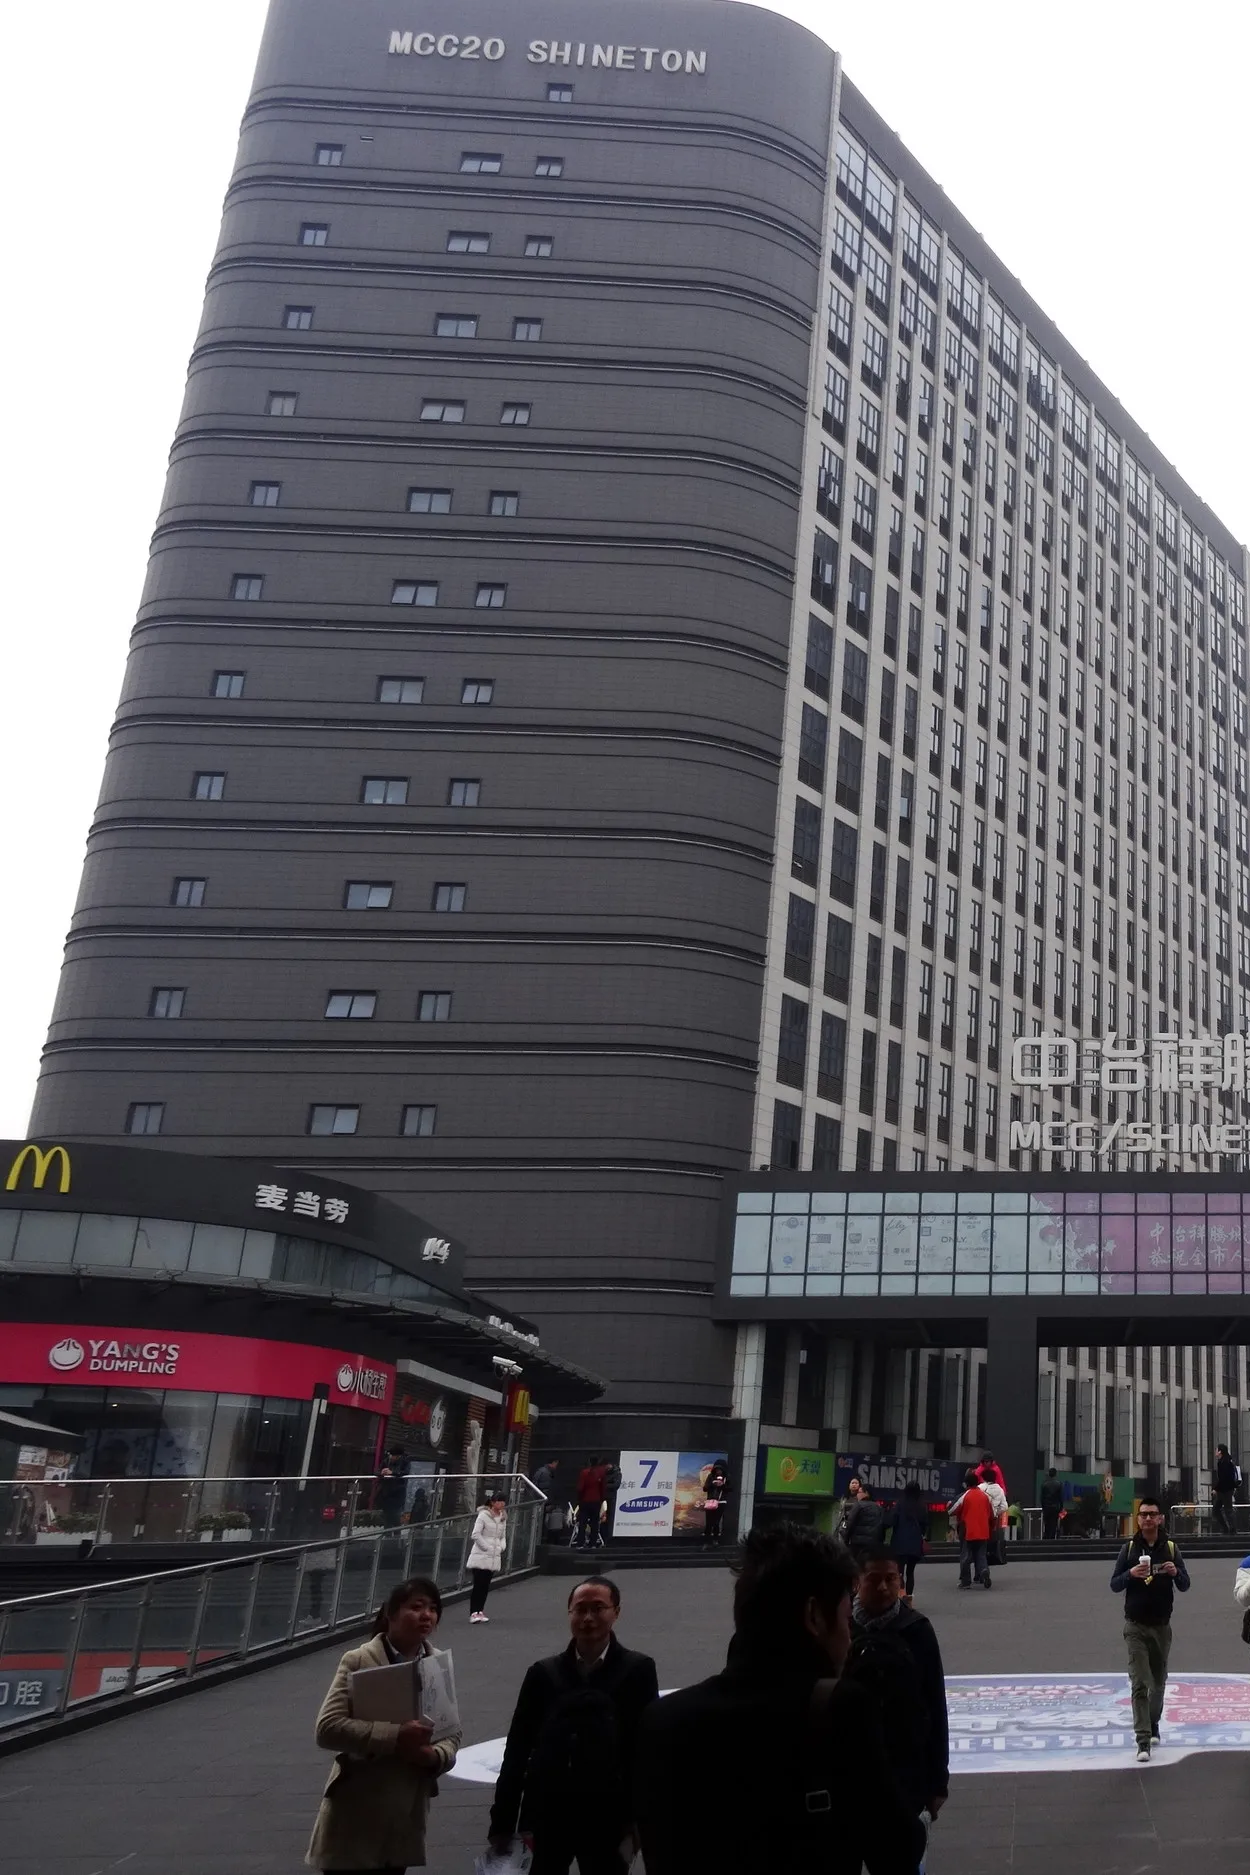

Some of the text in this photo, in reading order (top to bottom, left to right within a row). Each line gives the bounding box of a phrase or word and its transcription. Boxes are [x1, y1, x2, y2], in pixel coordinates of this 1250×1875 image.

[388, 30, 707, 74] MCC20 SHINETON
[255, 1184, 350, 1224] 麦当劳
[89, 1340, 180, 1361] YANG'S
[89, 1359, 176, 1374] DUMPLING
[639, 1460, 659, 1489] 7
[857, 1463, 941, 1492] SAMSUNG
[625, 1500, 665, 1509] SAMSUNG
